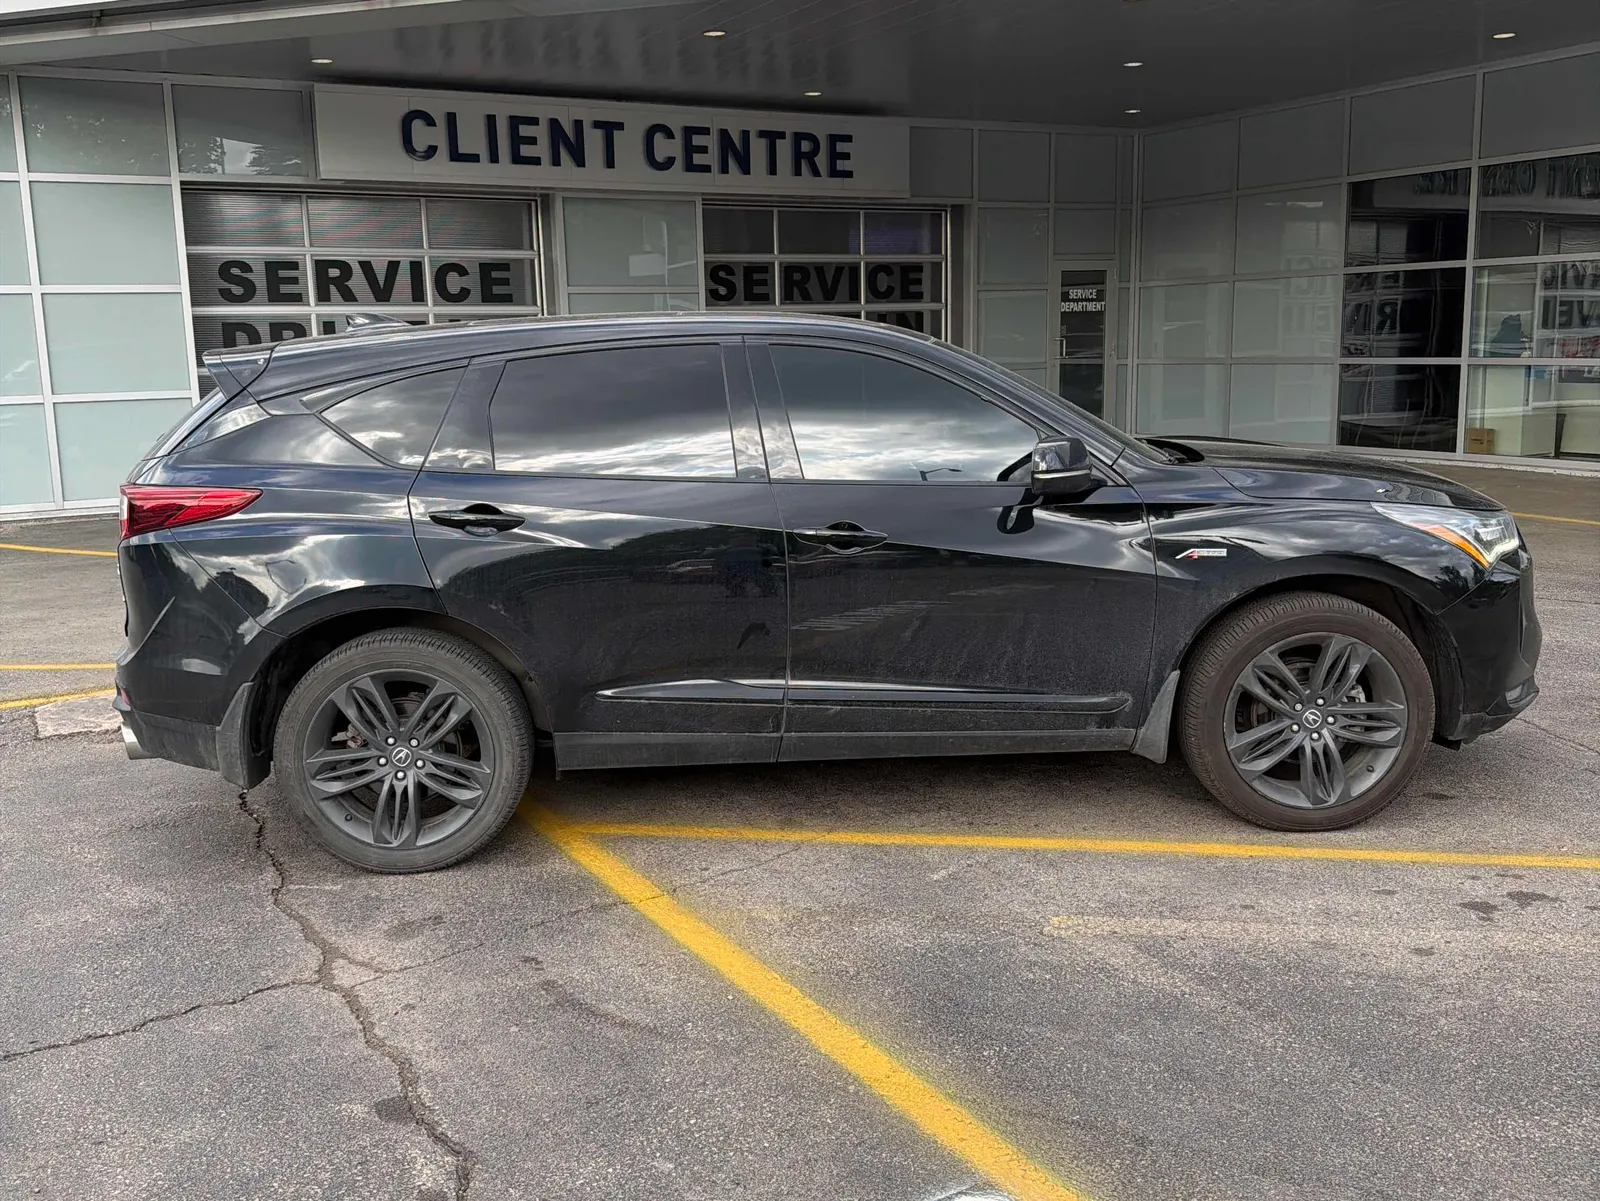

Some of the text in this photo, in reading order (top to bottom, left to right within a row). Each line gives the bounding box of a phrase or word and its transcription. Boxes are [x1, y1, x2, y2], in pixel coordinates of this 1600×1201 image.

[401, 109, 854, 179] CLIENT CENTRE
[217, 259, 514, 304] SERVICE
[708, 263, 925, 302] SERVICE
[1068, 289, 1097, 299] SERVICE
[1060, 301, 1106, 312] DEPARTMENT
